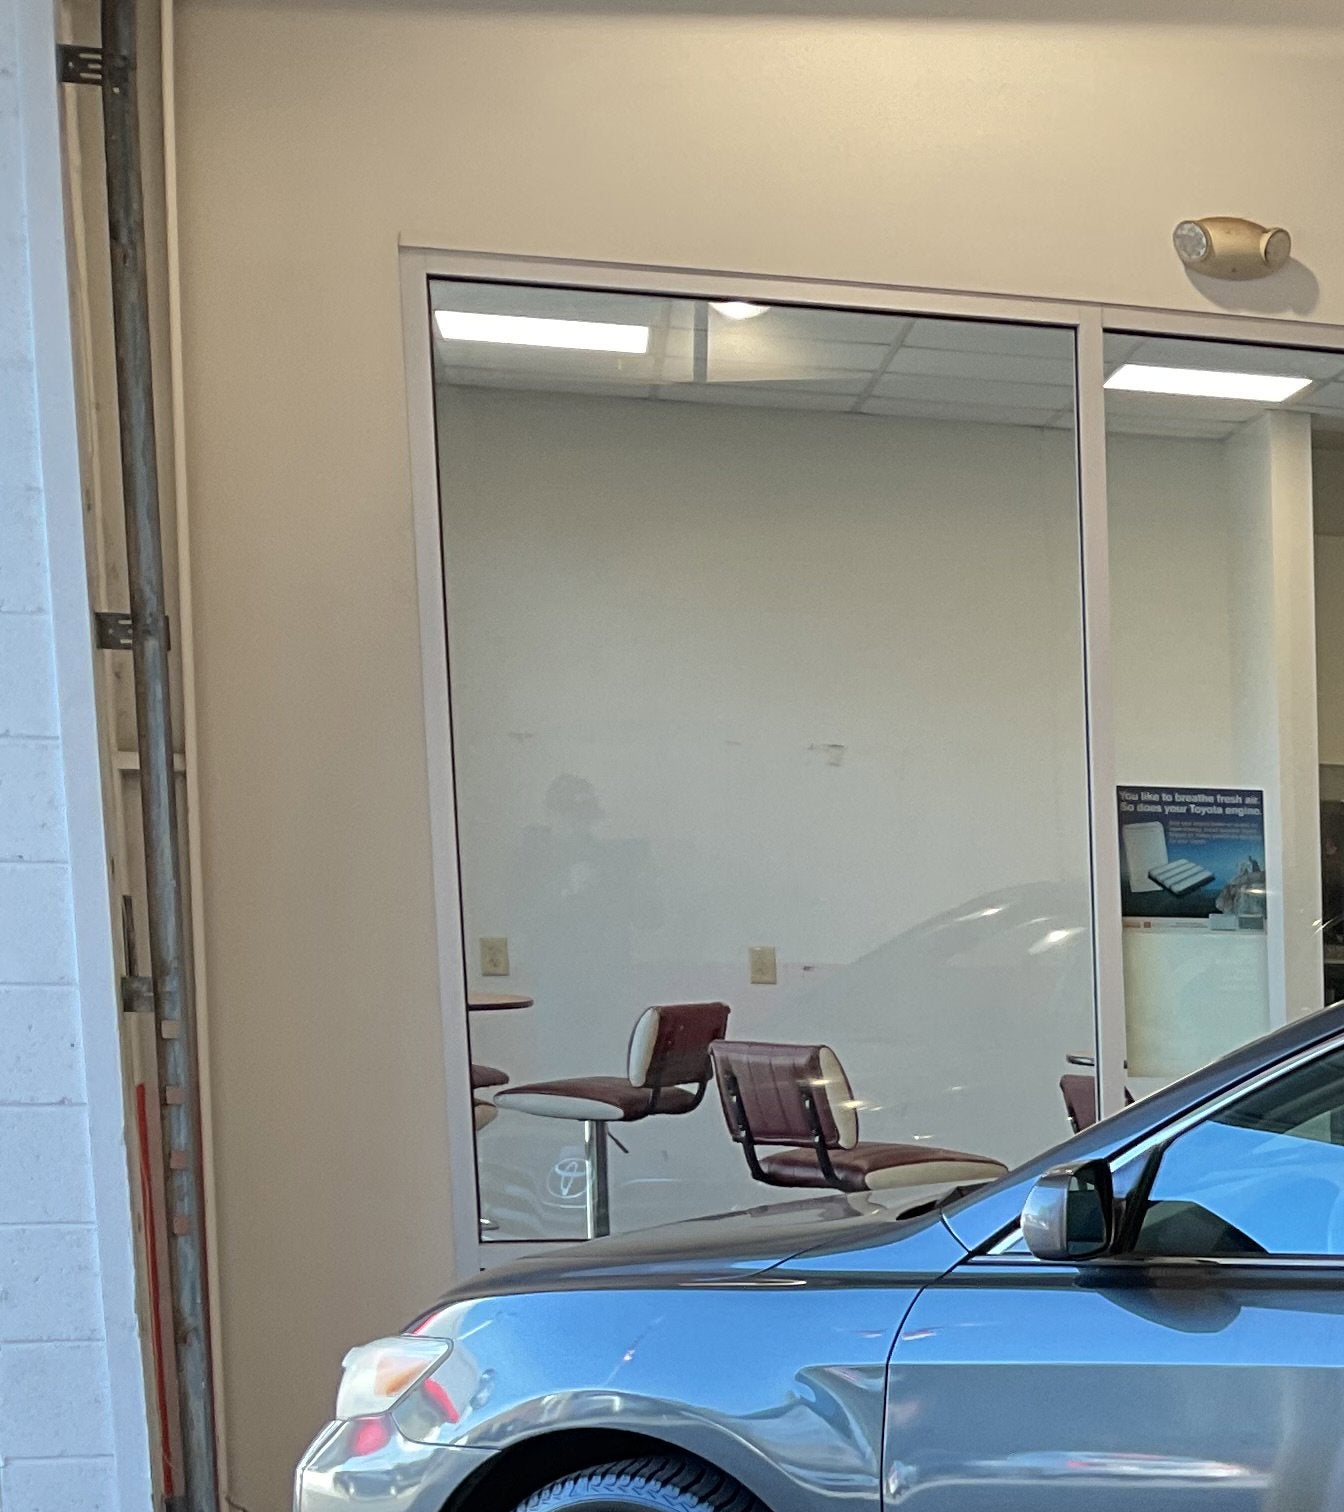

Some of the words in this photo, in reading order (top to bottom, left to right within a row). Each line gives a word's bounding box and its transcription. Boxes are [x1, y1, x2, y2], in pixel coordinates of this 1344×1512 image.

[1119, 790, 1138, 800] You
[1141, 791, 1159, 801] like
[1162, 793, 1173, 802] to
[1175, 793, 1214, 803] breathe
[1216, 795, 1242, 804] fresh
[1120, 802, 1135, 812] So
[1137, 804, 1162, 812] does
[1164, 805, 1187, 815] your
[1190, 804, 1223, 815] Toyota
